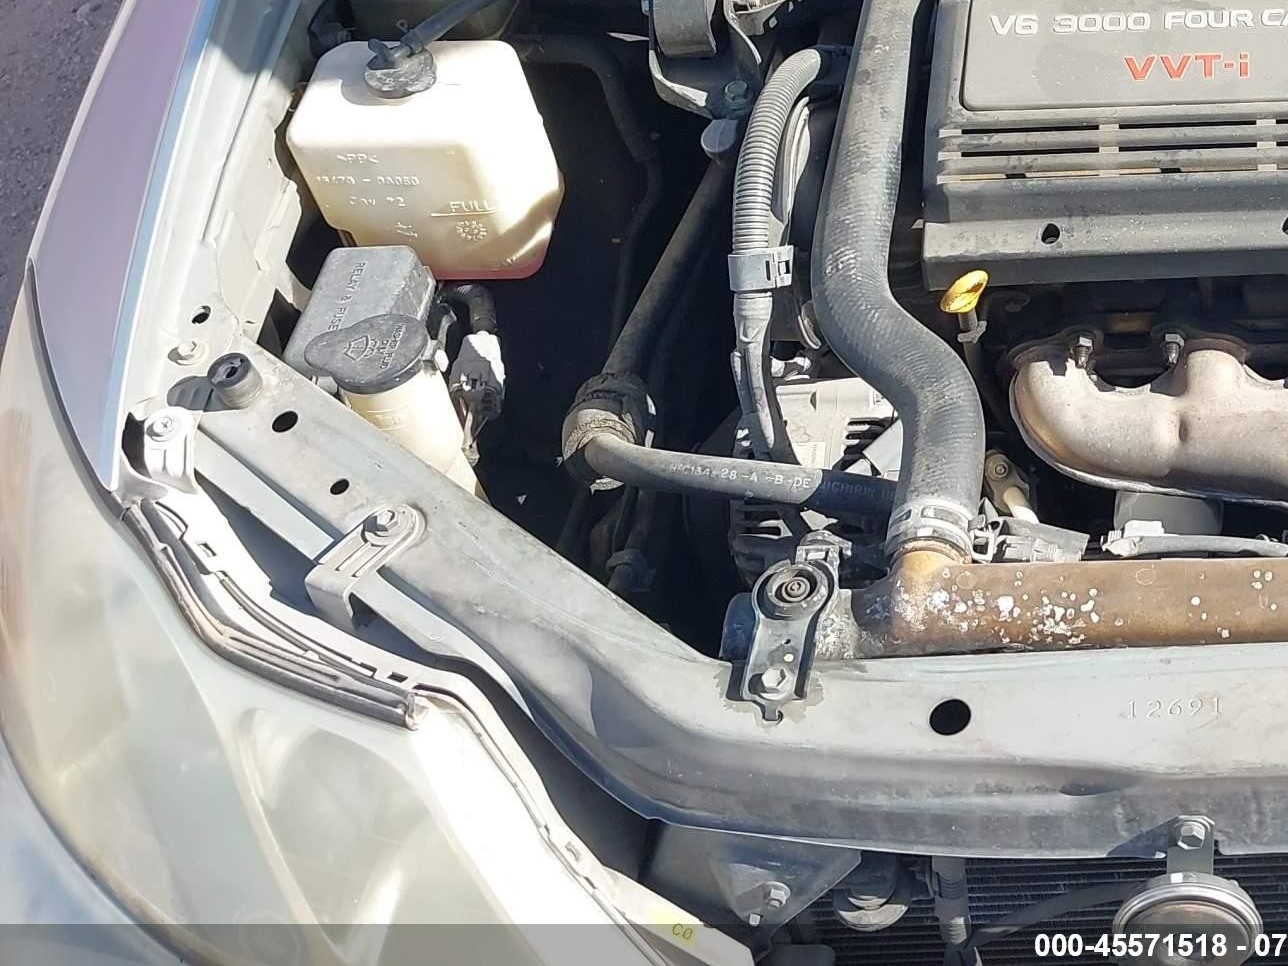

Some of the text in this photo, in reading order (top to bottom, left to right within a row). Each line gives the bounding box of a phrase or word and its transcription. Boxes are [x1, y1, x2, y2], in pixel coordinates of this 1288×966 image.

[990, 14, 1039, 35] V6
[1052, 12, 1151, 34] 3000
[1164, 9, 1254, 30] FOUR
[1124, 52, 1249, 81] VVT-i
[450, 200, 496, 212] FULL
[345, 261, 366, 290] RELAY
[328, 306, 348, 330] FUSE
[1127, 697, 1222, 718] 12691
